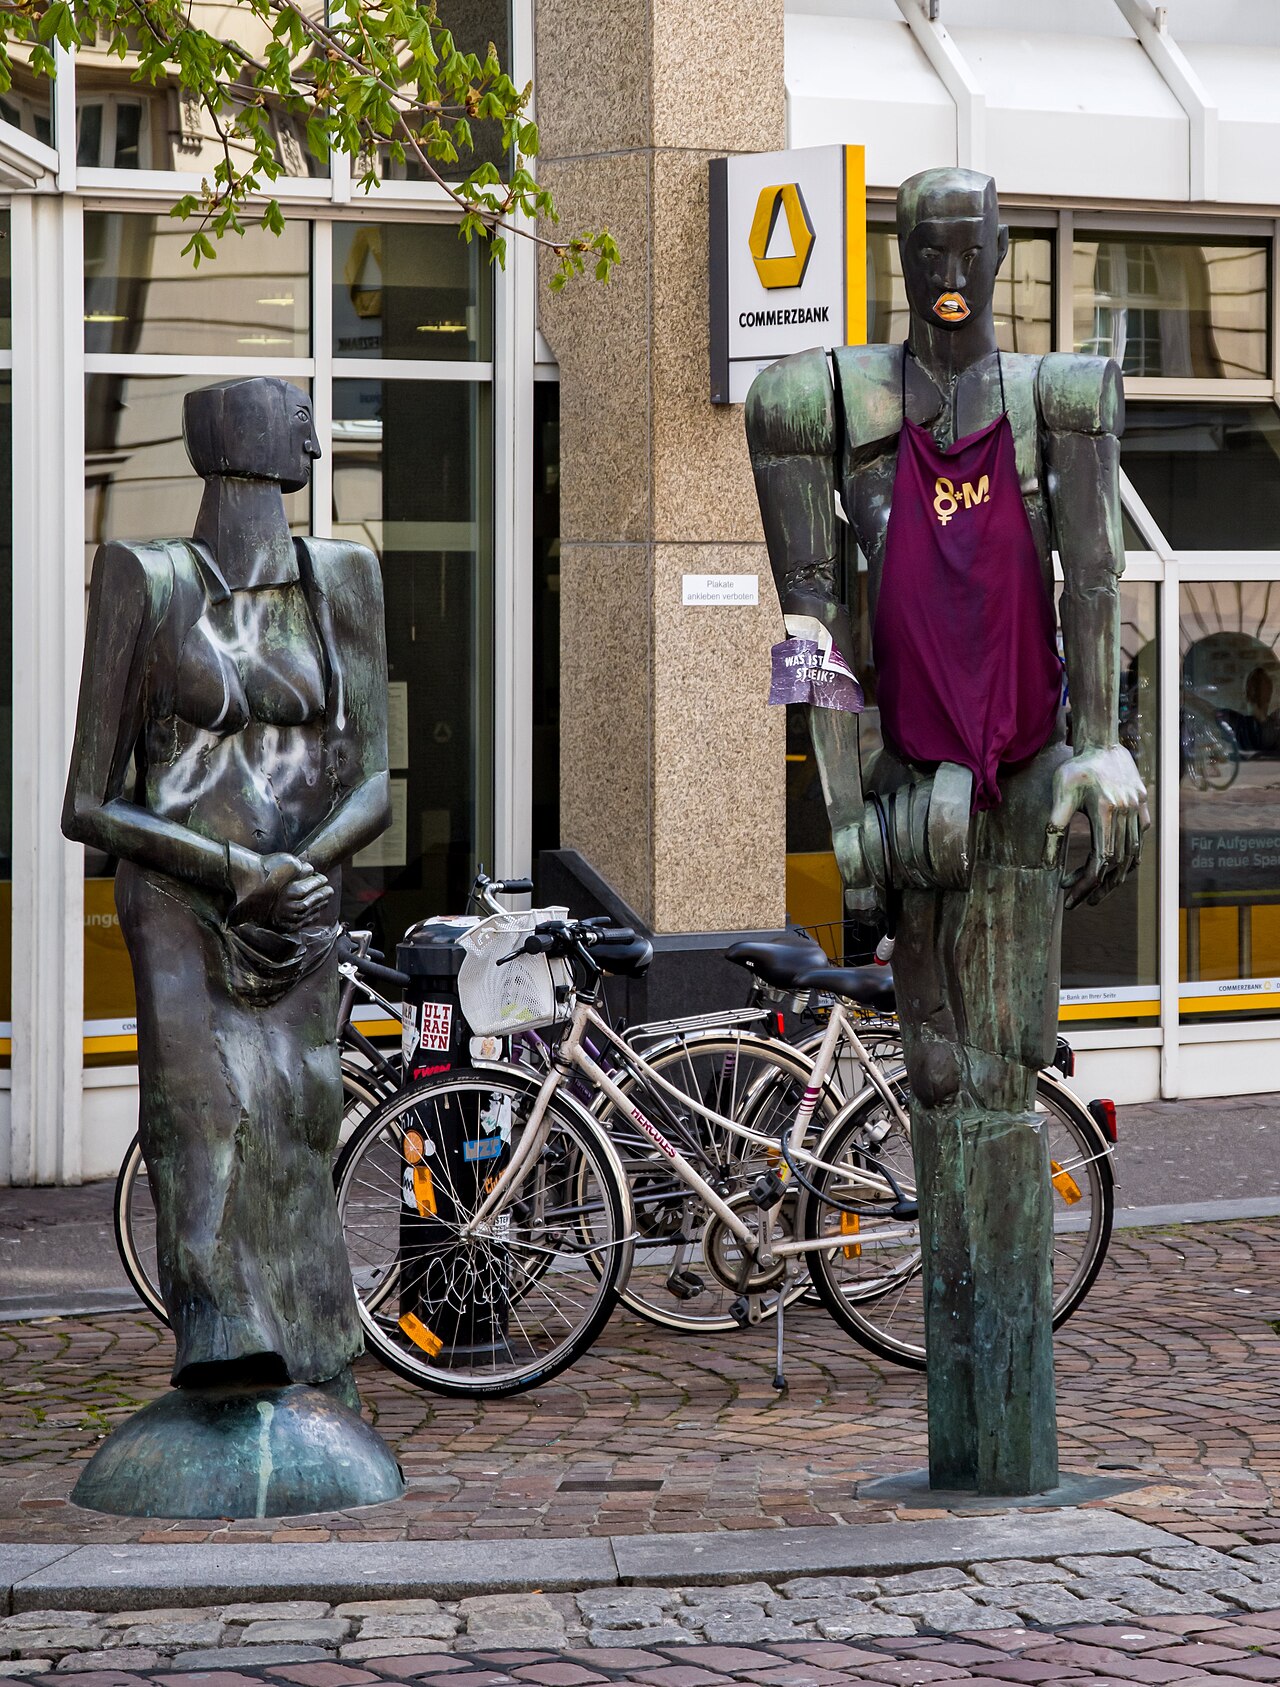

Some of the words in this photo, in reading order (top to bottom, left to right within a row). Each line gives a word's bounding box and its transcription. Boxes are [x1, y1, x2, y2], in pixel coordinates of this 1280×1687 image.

[739, 306, 829, 328] COMMERZBANK
[706, 580, 734, 588] Plakate
[722, 592, 754, 600] verboten
[785, 655, 804, 667] WAS
[808, 654, 824, 666] IST
[796, 667, 835, 682] STEIK?
[1191, 836, 1213, 850] Für
[1191, 856, 1215, 868] das
[1218, 856, 1249, 867] neue
[1218, 984, 1262, 992] COMMERZBANK
[424, 1003, 451, 1020] ULT
[423, 1018, 449, 1034] RAS
[422, 1033, 448, 1050] SYN
[631, 1107, 676, 1158] HERCULES
